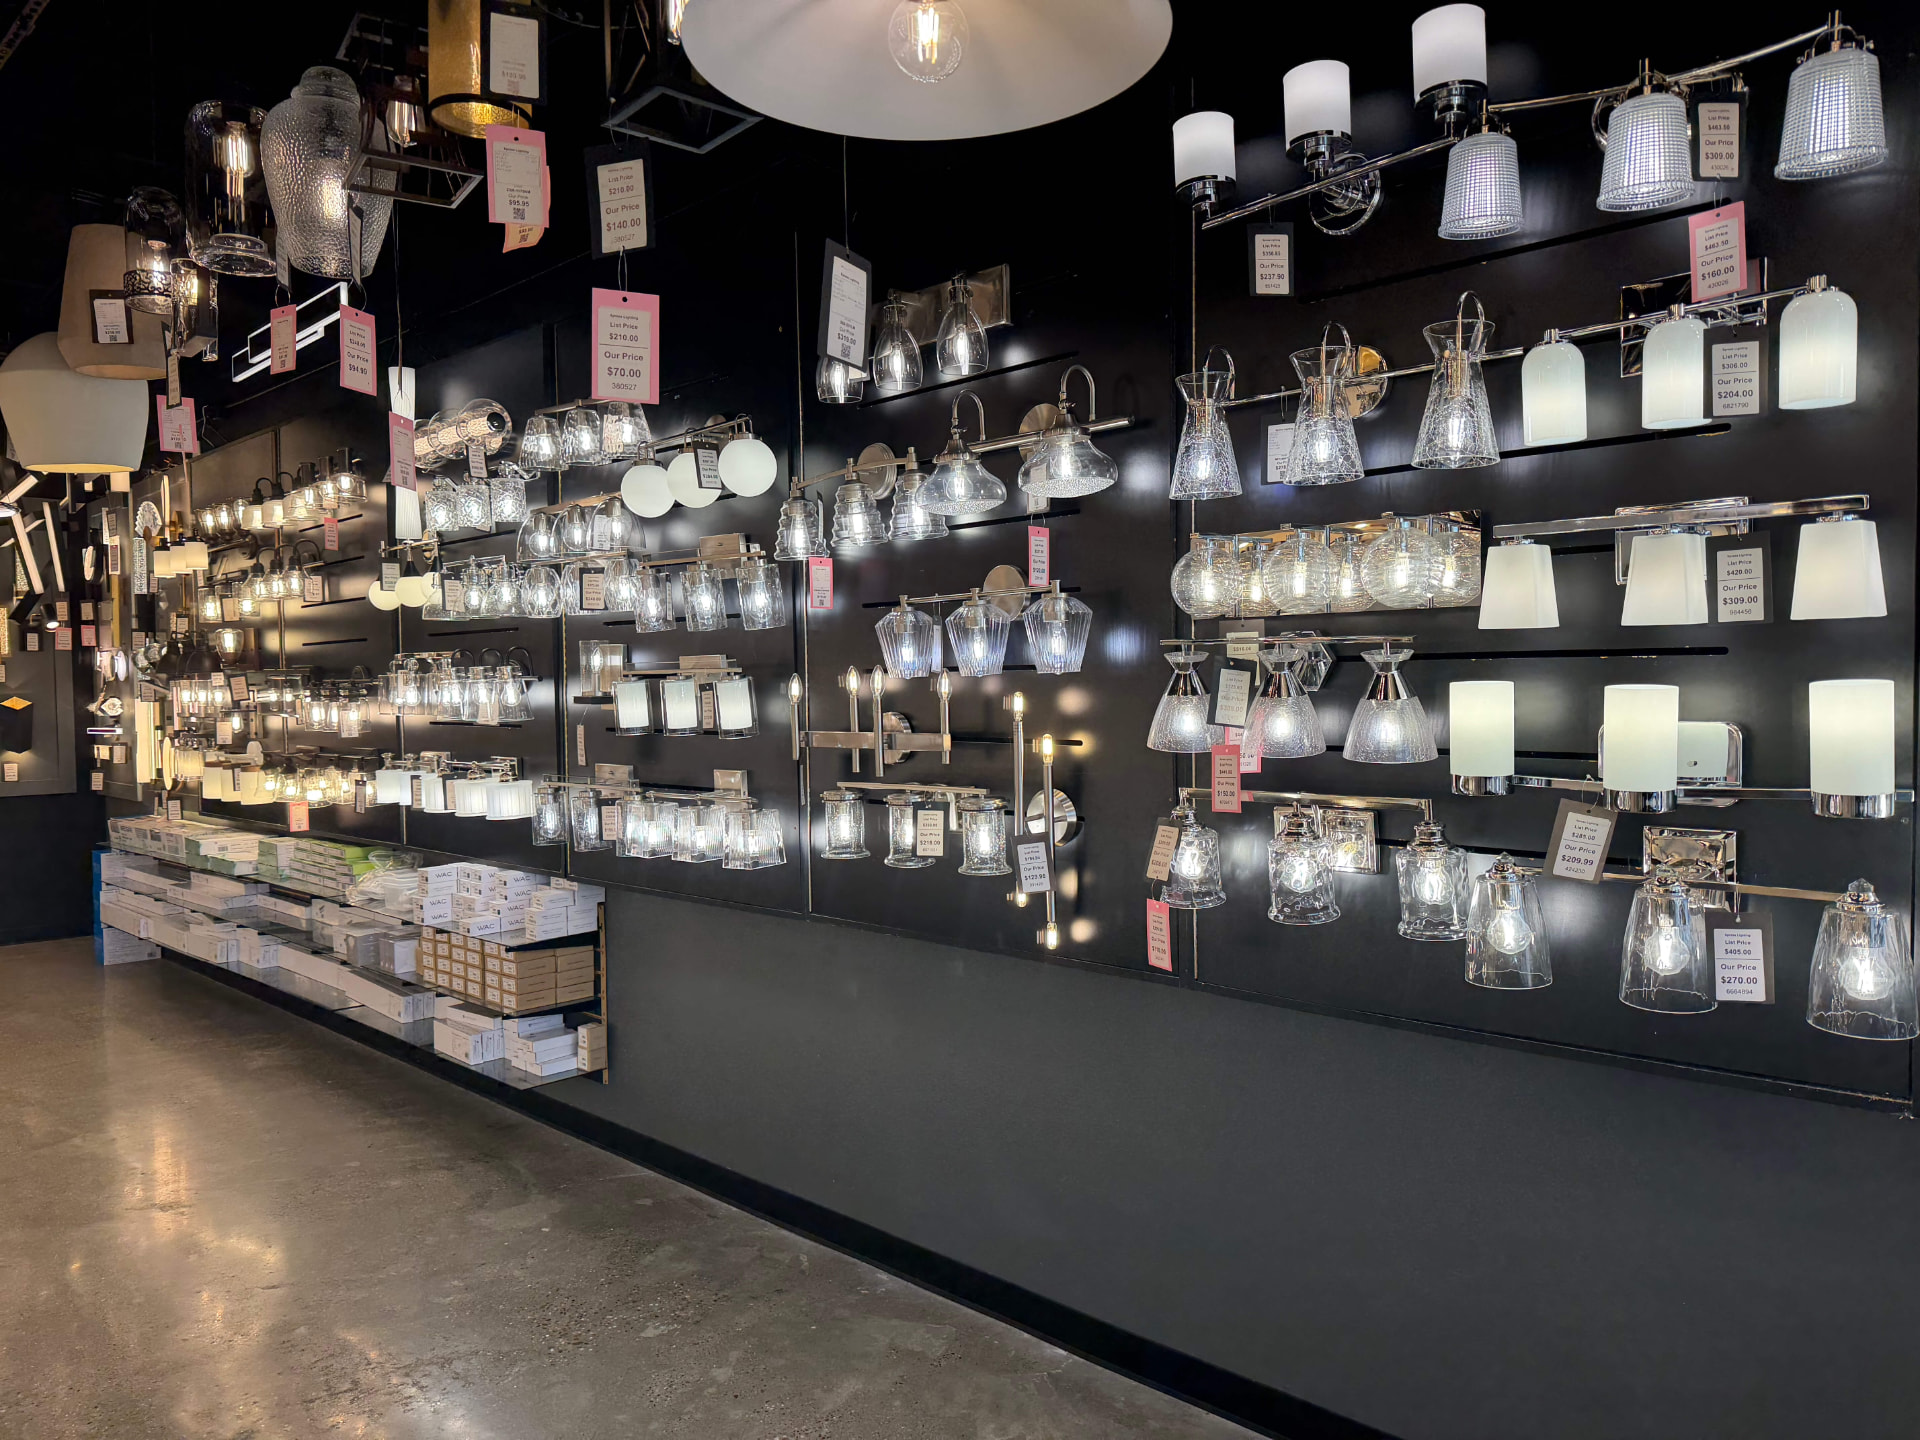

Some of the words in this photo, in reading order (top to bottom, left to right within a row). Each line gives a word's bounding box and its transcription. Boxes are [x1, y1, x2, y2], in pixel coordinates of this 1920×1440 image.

[1705, 152, 1734, 160] $309.00
[609, 185, 634, 196] $210.00
[606, 207, 619, 215] Our
[622, 204, 640, 212] Price
[606, 218, 641, 232] $140.00
[1705, 240, 1729, 251] $463.50
[1701, 259, 1714, 267] Our
[1716, 254, 1734, 263] Price
[1701, 265, 1735, 281] $160.00
[609, 332, 639, 342] $210.00
[357, 355, 369, 363] Price
[604, 351, 620, 359] Our
[622, 352, 644, 361] Price
[1722, 362, 1748, 370] $306.00
[607, 367, 641, 378] $70.00
[612, 382, 637, 390] 380527
[1718, 390, 1753, 399] $204.00
[1722, 596, 1758, 606] $309.00
[1572, 832, 1596, 840] $285.00
[1561, 854, 1594, 866] $209.99
[508, 918, 525, 926] WAC
[1721, 976, 1758, 984] $270.00
